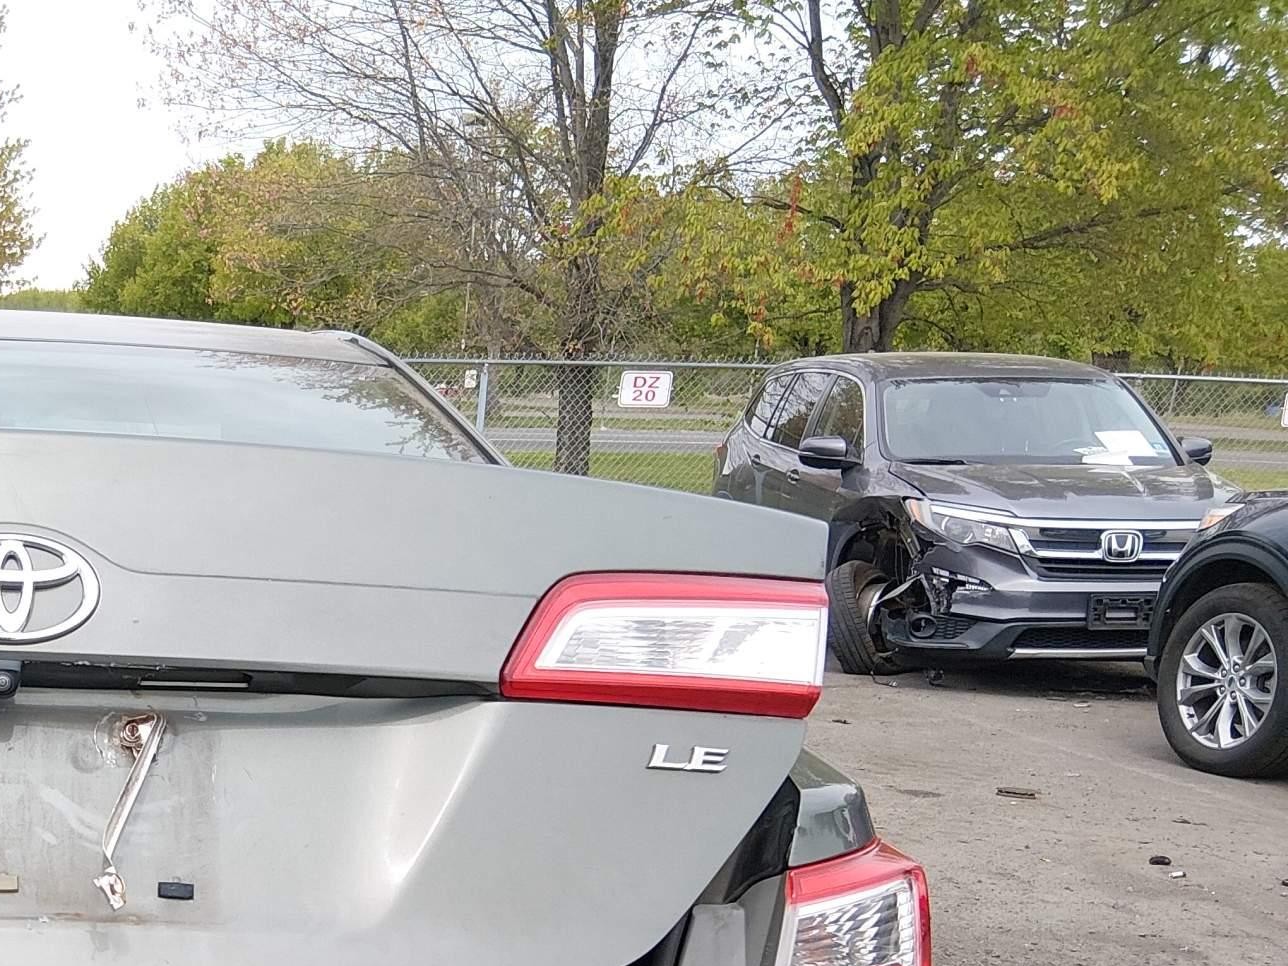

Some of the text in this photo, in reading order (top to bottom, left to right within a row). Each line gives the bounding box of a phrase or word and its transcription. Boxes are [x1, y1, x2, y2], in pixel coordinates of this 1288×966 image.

[633, 376, 661, 389] DZ
[632, 389, 656, 402] 20
[645, 743, 730, 774] LE
